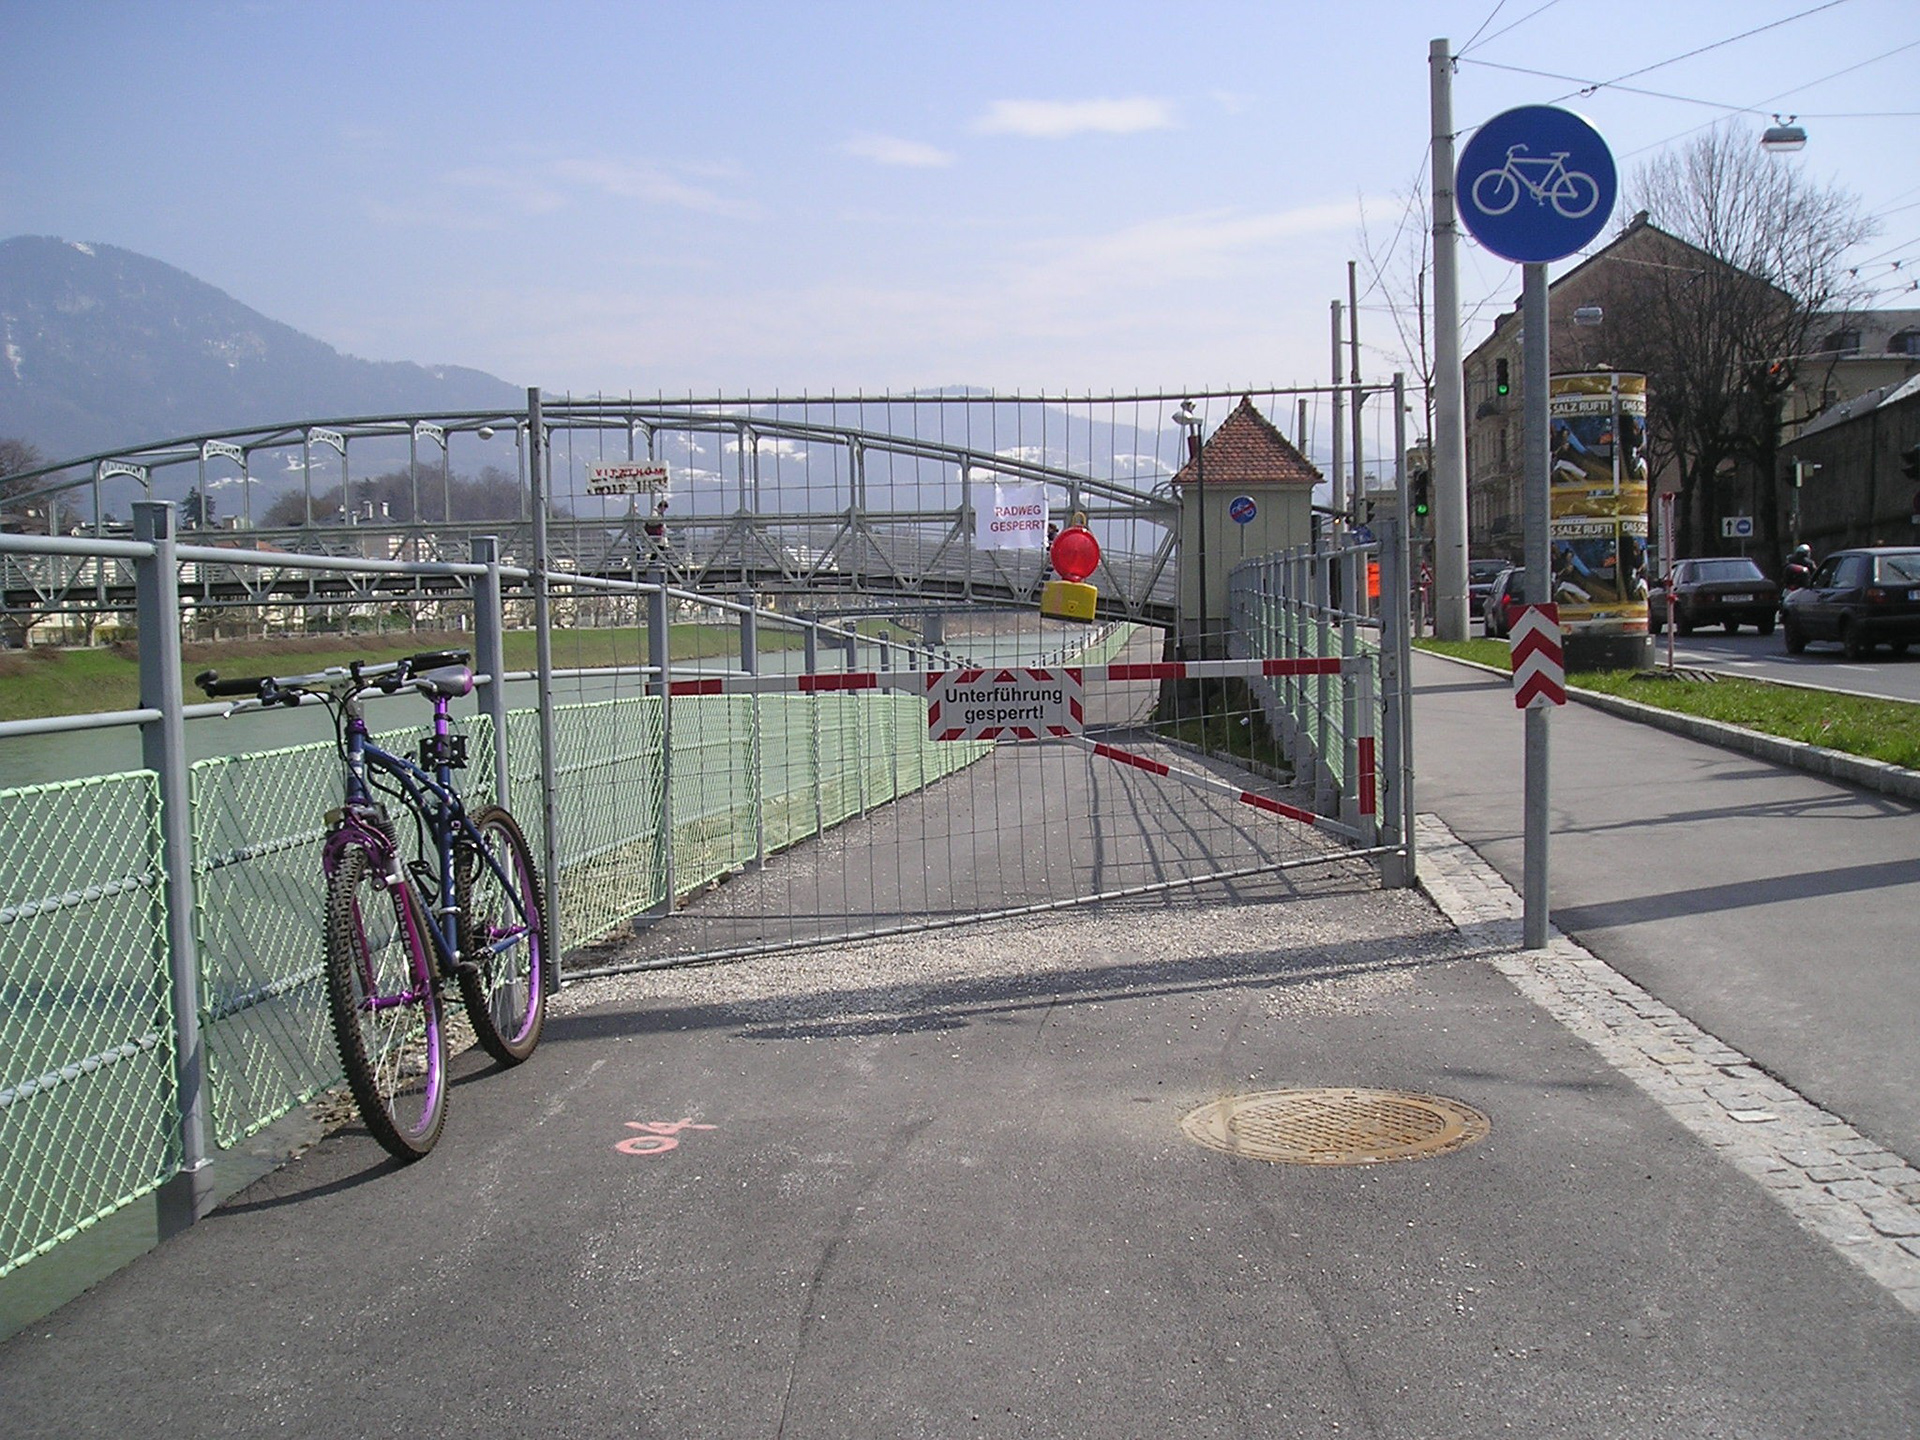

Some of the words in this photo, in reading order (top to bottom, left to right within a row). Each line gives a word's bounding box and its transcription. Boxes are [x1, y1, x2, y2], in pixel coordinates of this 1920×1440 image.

[995, 505, 1041, 517] RADWEG
[990, 520, 1046, 532] GESPERRT
[1557, 526, 1582, 536] SALZ
[1583, 524, 1613, 534] RUFT!
[945, 688, 1063, 703] Unterführung
[964, 706, 1044, 724] gesperrt!
